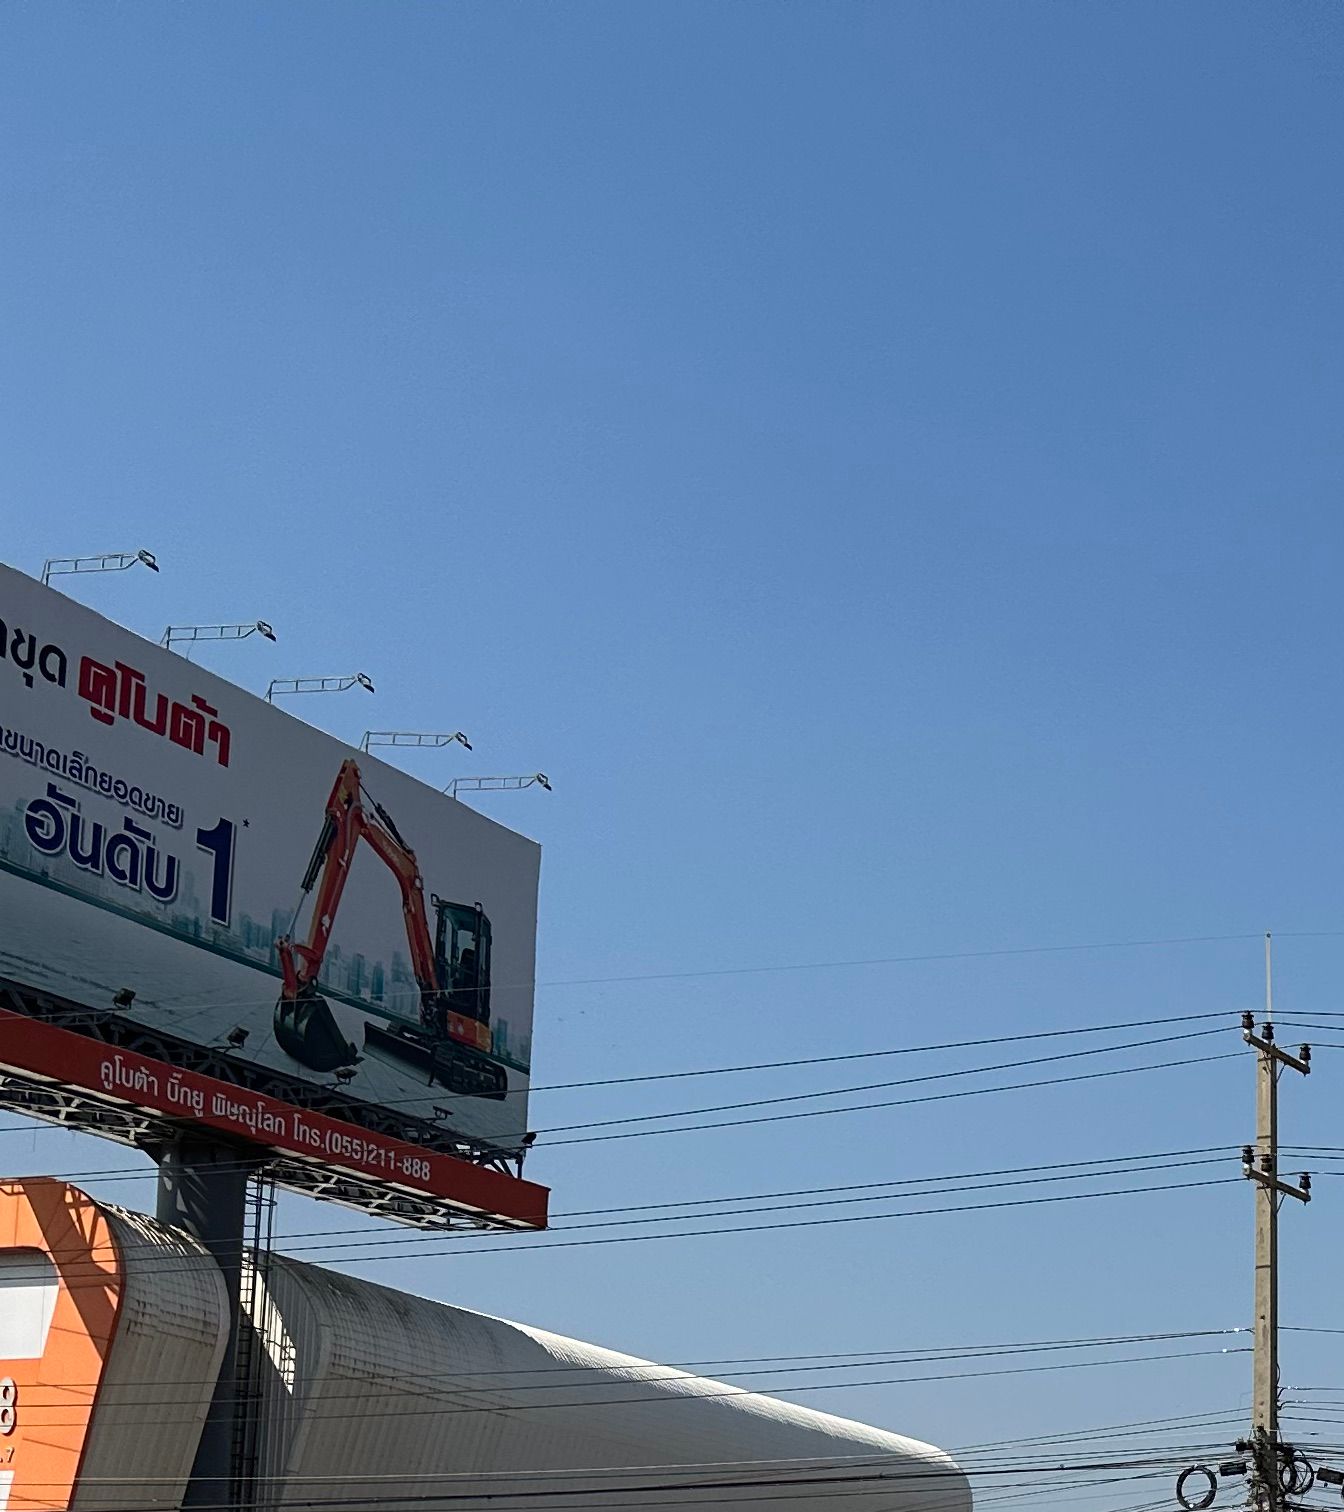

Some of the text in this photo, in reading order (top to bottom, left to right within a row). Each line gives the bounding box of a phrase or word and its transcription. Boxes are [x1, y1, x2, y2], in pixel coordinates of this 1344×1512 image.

[78, 655, 231, 768] คูโบต้า
[25, 781, 178, 901] อันดับ
[101, 1055, 158, 1096] คูโบต้า
[166, 1072, 204, 1117] บิ๊กยู
[212, 1092, 285, 1135] พิษณุโลก
